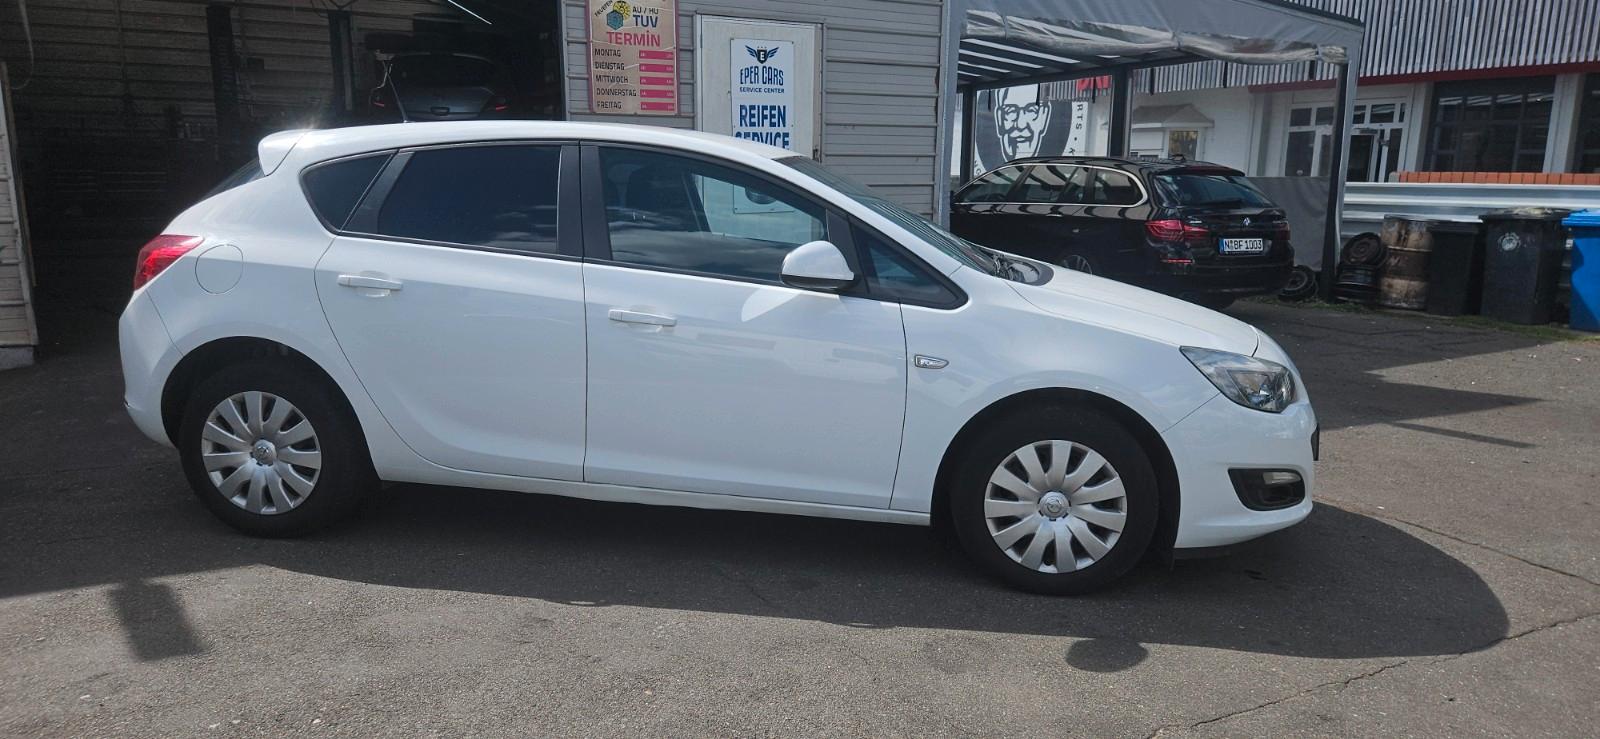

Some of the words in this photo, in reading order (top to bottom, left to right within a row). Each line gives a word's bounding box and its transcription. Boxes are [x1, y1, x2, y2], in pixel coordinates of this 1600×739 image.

[594, 48, 621, 57] MONTAG
[594, 62, 624, 70] DIENSTAG
[595, 75, 628, 83] MITTWOCH
[740, 66, 759, 85] EPER
[762, 66, 784, 86] CARS
[596, 88, 636, 96] DONNERSTAG
[597, 101, 622, 109] FREITAG
[740, 104, 786, 128] REIFEN
[1225, 240, 1230, 250] N
[1234, 240, 1243, 249] BF
[1245, 240, 1262, 249] 1003
